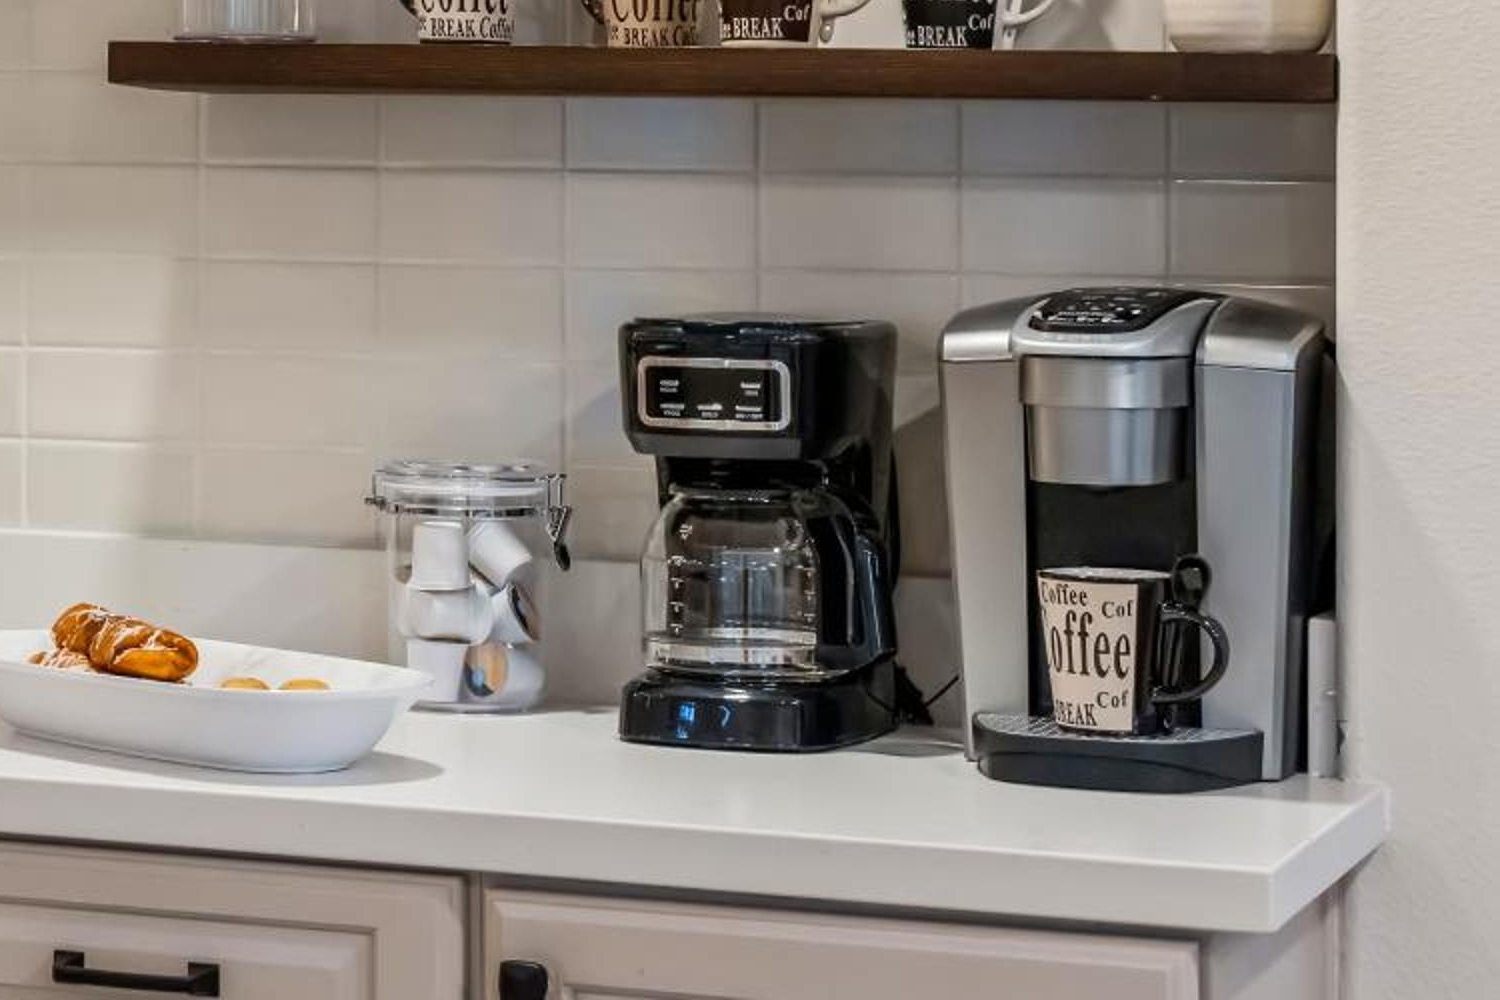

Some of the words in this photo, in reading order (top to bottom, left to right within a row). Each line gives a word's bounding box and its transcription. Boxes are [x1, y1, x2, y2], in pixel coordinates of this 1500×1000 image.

[430, 17, 476, 38] BREAK
[732, 17, 786, 39] BREAK
[917, 25, 968, 47] BREAK
[1041, 581, 1088, 607] Coffee
[1050, 609, 1132, 680] offee
